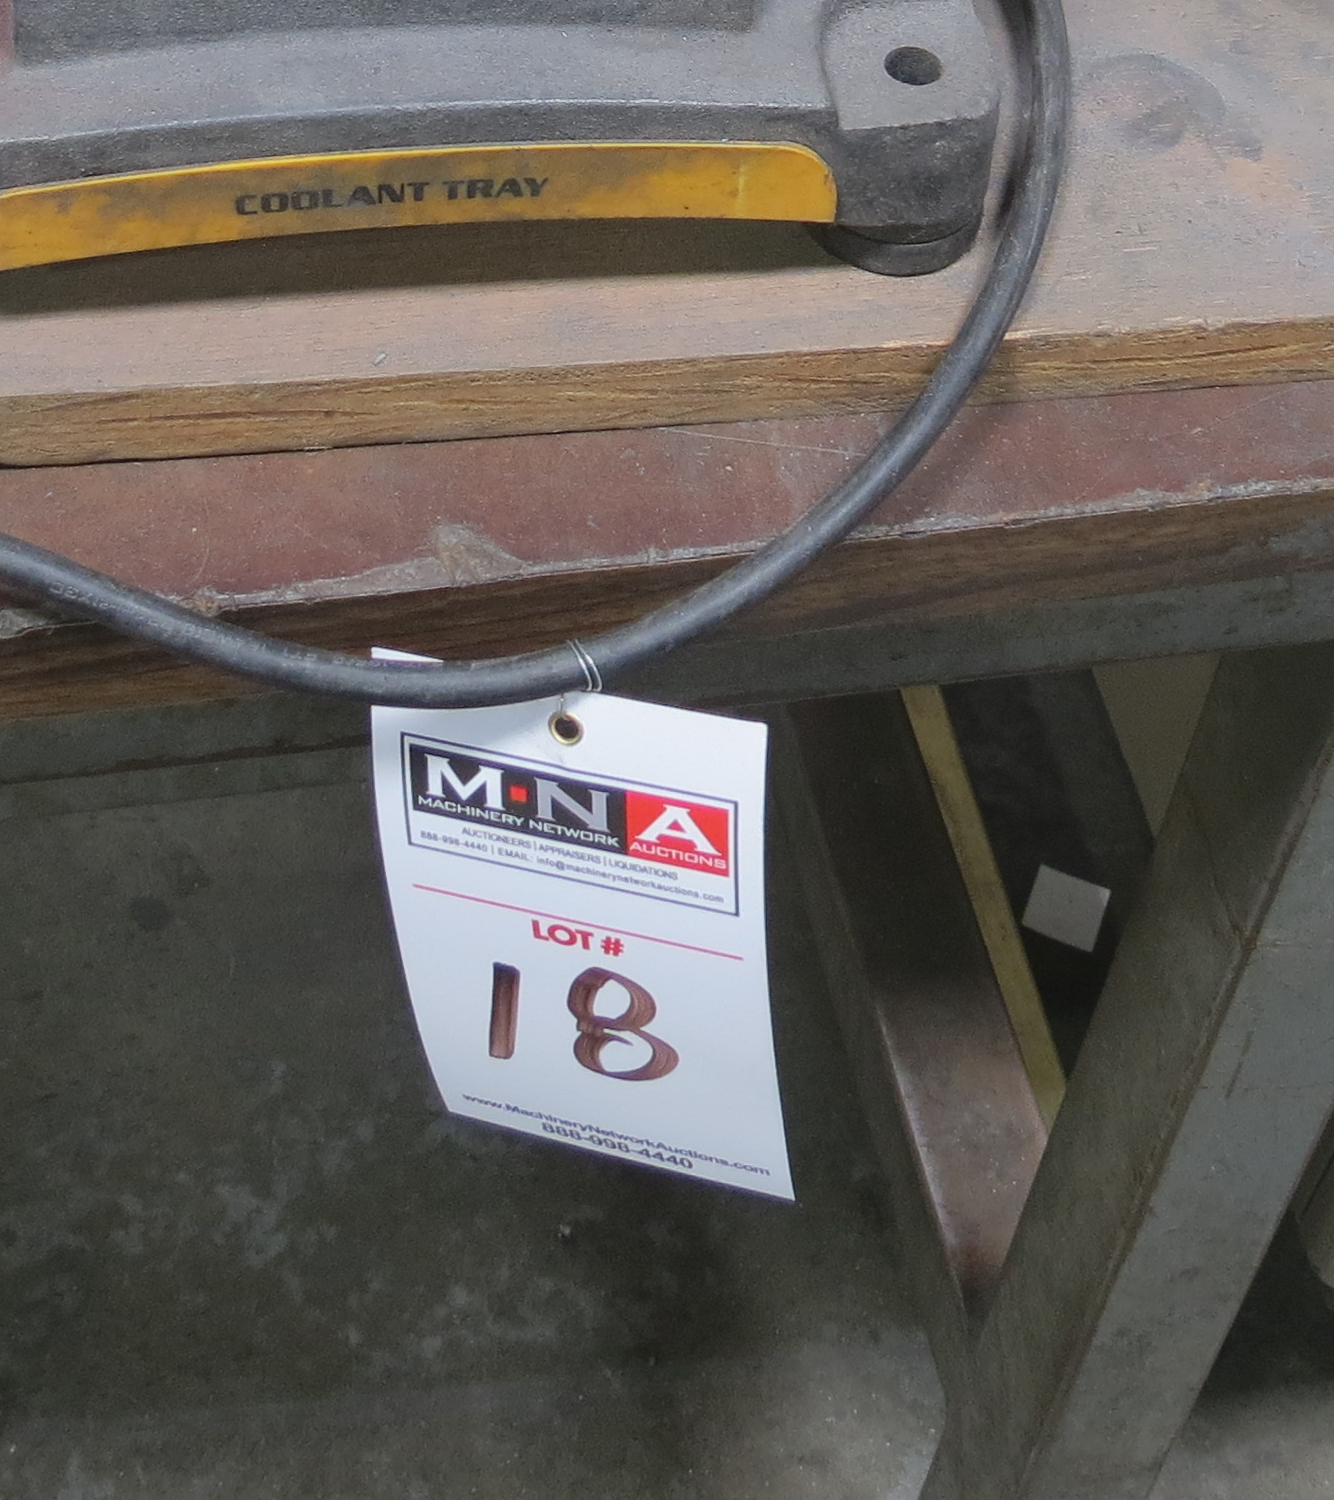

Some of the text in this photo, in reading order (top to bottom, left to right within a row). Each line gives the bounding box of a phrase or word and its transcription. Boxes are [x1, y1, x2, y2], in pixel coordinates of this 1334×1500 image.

[236, 178, 548, 215] COOLANT TRAY
[418, 796, 726, 869] MACHINERY NETWORK AUCTIONS
[461, 827, 678, 881] AUCTIONEERS APPRAISERS LIQUIDATIONS
[498, 847, 533, 863] EMAIL:
[536, 857, 724, 903] info@machinerynetworkauctions.com
[531, 919, 624, 956] LOT #
[489, 962, 679, 1081] 18
[462, 1092, 770, 1177] www.MachineryNetworkAuctions.com
[542, 1121, 693, 1170] 888-998-4440
